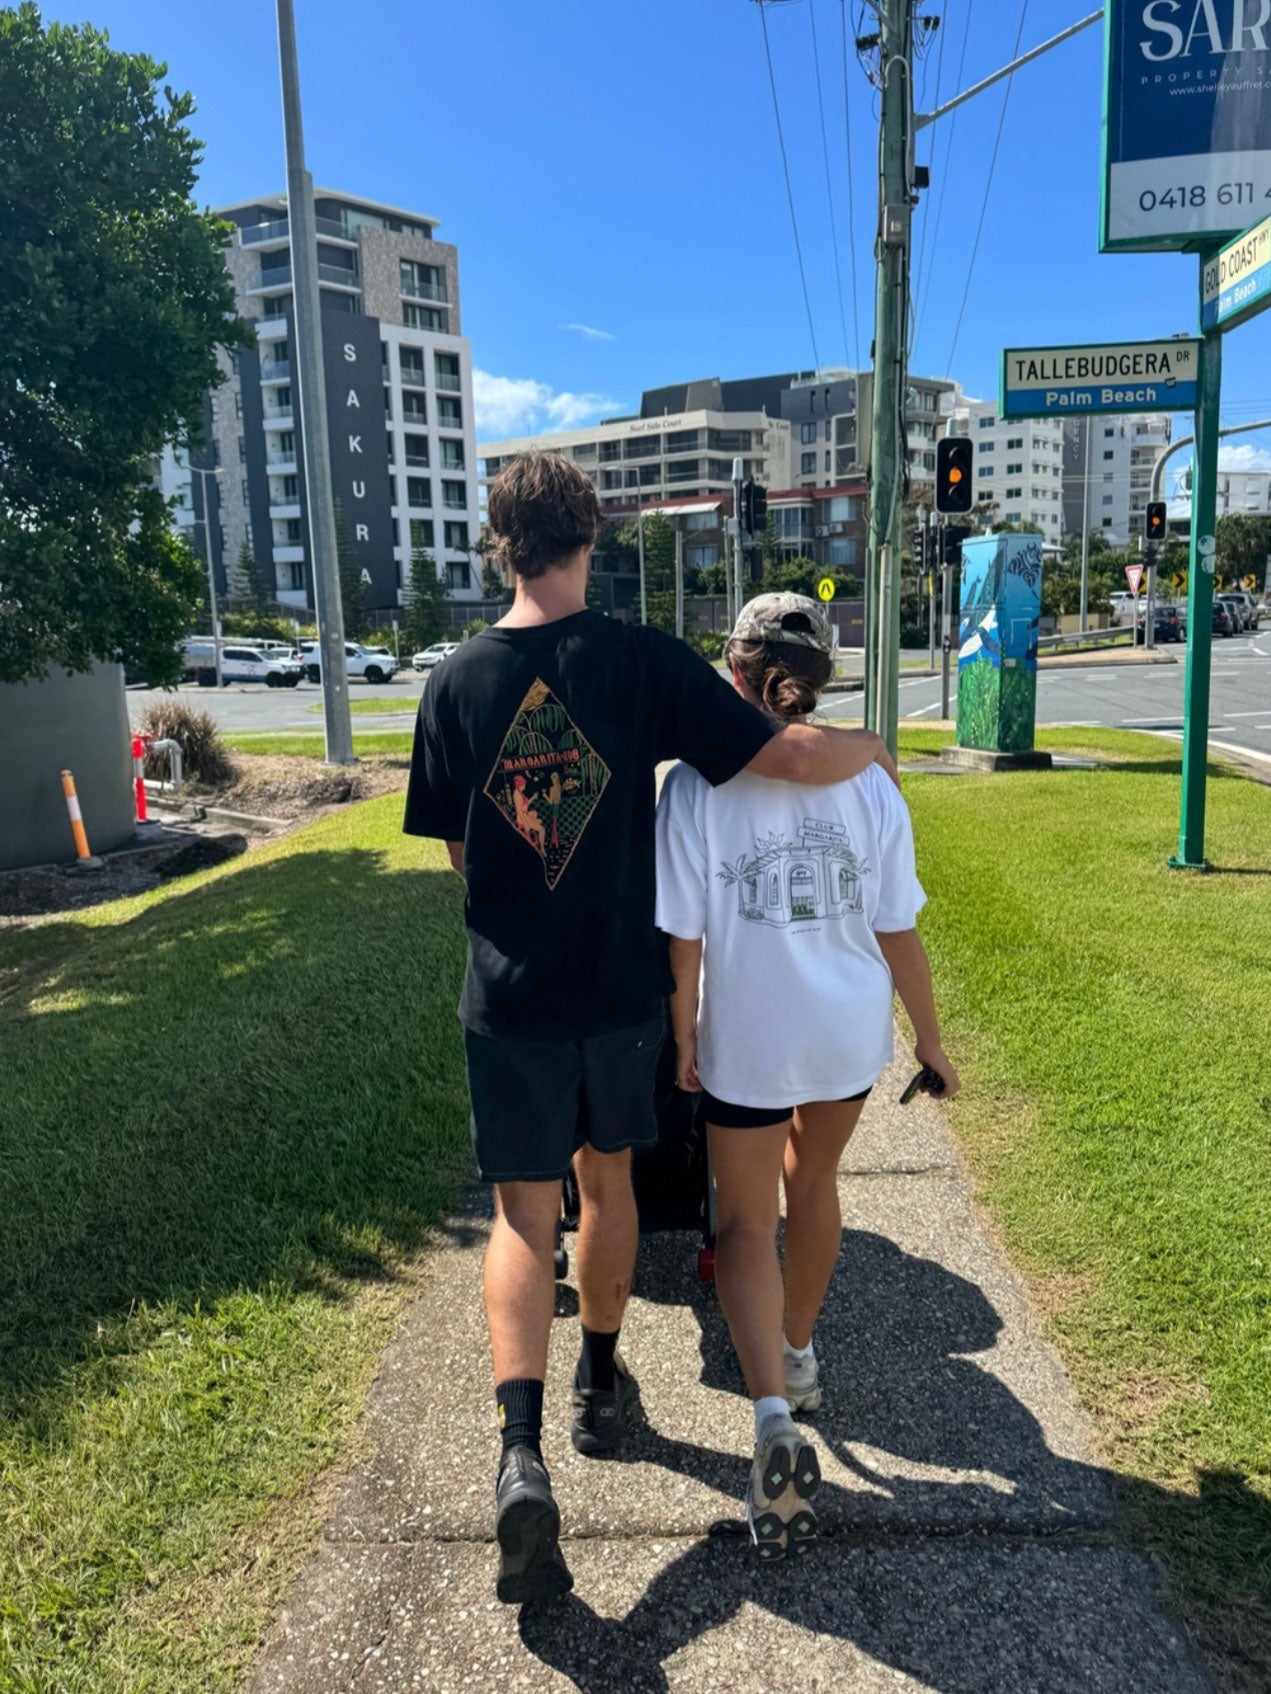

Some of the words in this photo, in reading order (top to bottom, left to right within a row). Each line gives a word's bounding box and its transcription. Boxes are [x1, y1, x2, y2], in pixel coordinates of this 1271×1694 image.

[1141, 66, 1242, 85] PROPERTY
[1139, 185, 1206, 212] 0418
[1217, 182, 1254, 205] 611
[1205, 260, 1226, 294] GOLD
[1228, 236, 1258, 278] COAST
[1214, 296, 1232, 316] Palm
[1233, 278, 1256, 304] Beach
[1016, 352, 1171, 381] TALLEBUDGERA
[1176, 350, 1190, 363] DR
[1046, 391, 1092, 406] Palm
[1101, 387, 1156, 404] Beach
[629, 423, 646, 434] Surf
[662, 418, 682, 428] Court
[343, 343, 373, 585] SAKURA
